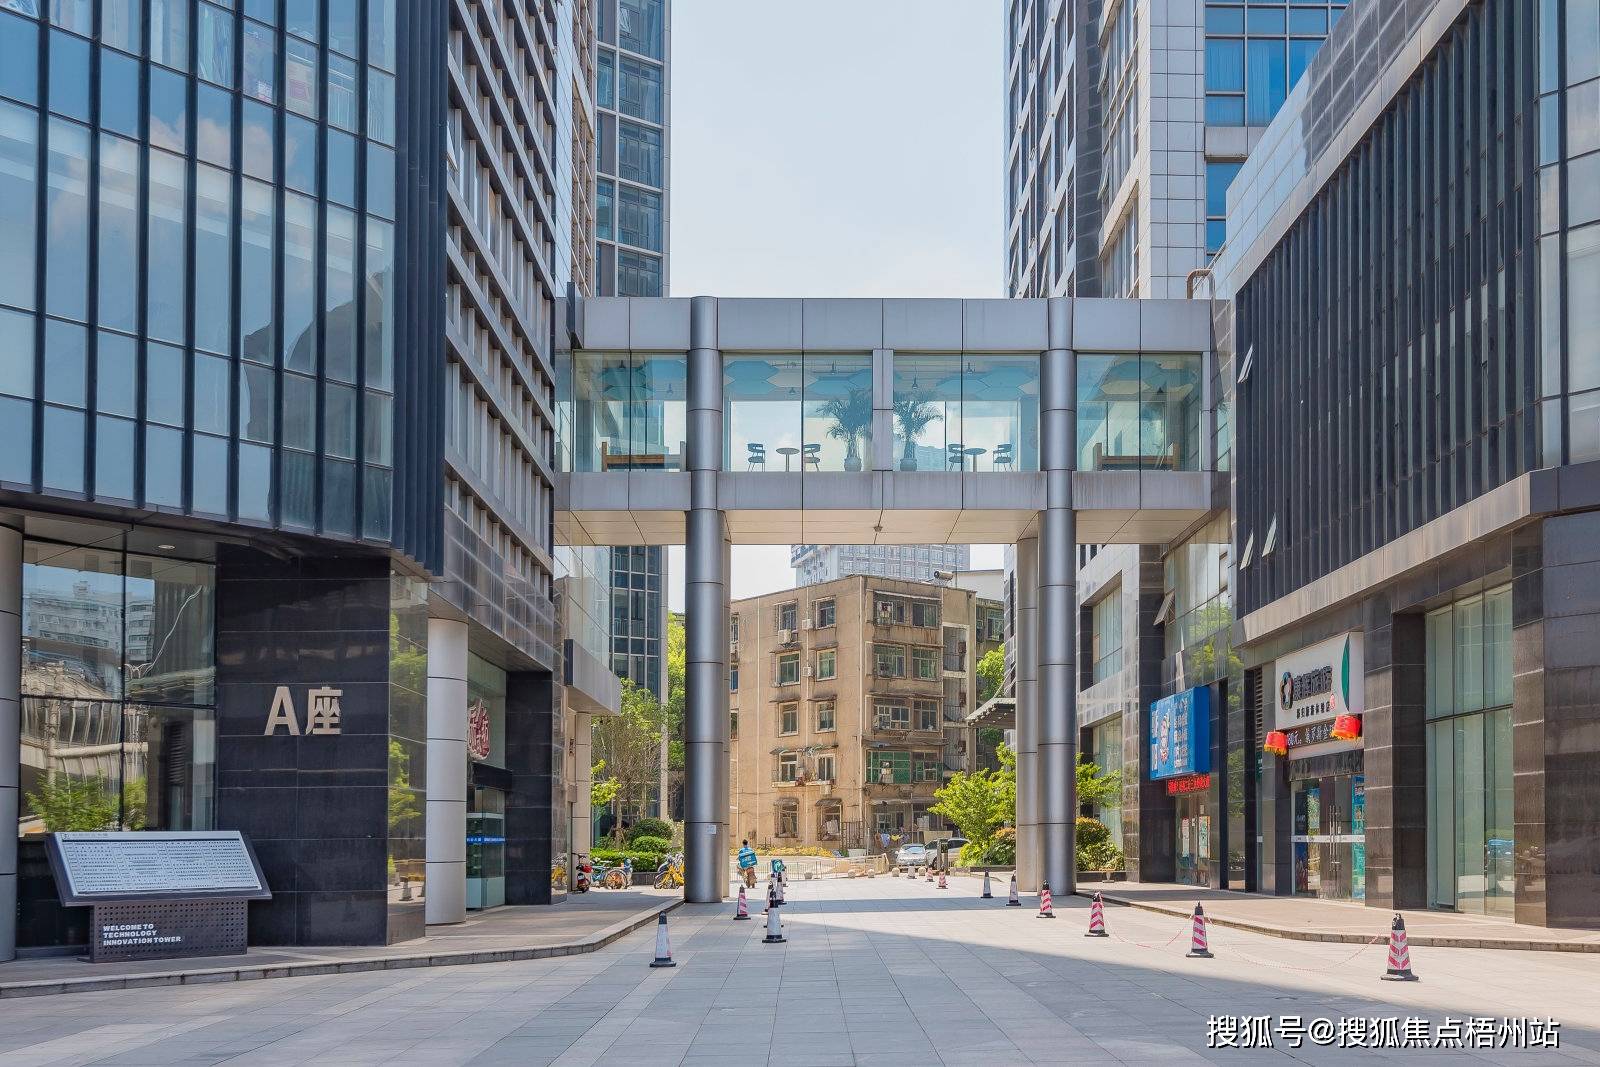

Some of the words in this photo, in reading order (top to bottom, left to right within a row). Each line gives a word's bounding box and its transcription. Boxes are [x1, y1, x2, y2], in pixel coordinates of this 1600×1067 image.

[264, 686, 343, 735] A座
[103, 930, 157, 938] TECHNOLOGY
[103, 938, 153, 946] INNOVATION
[154, 936, 182, 944] TOWER
